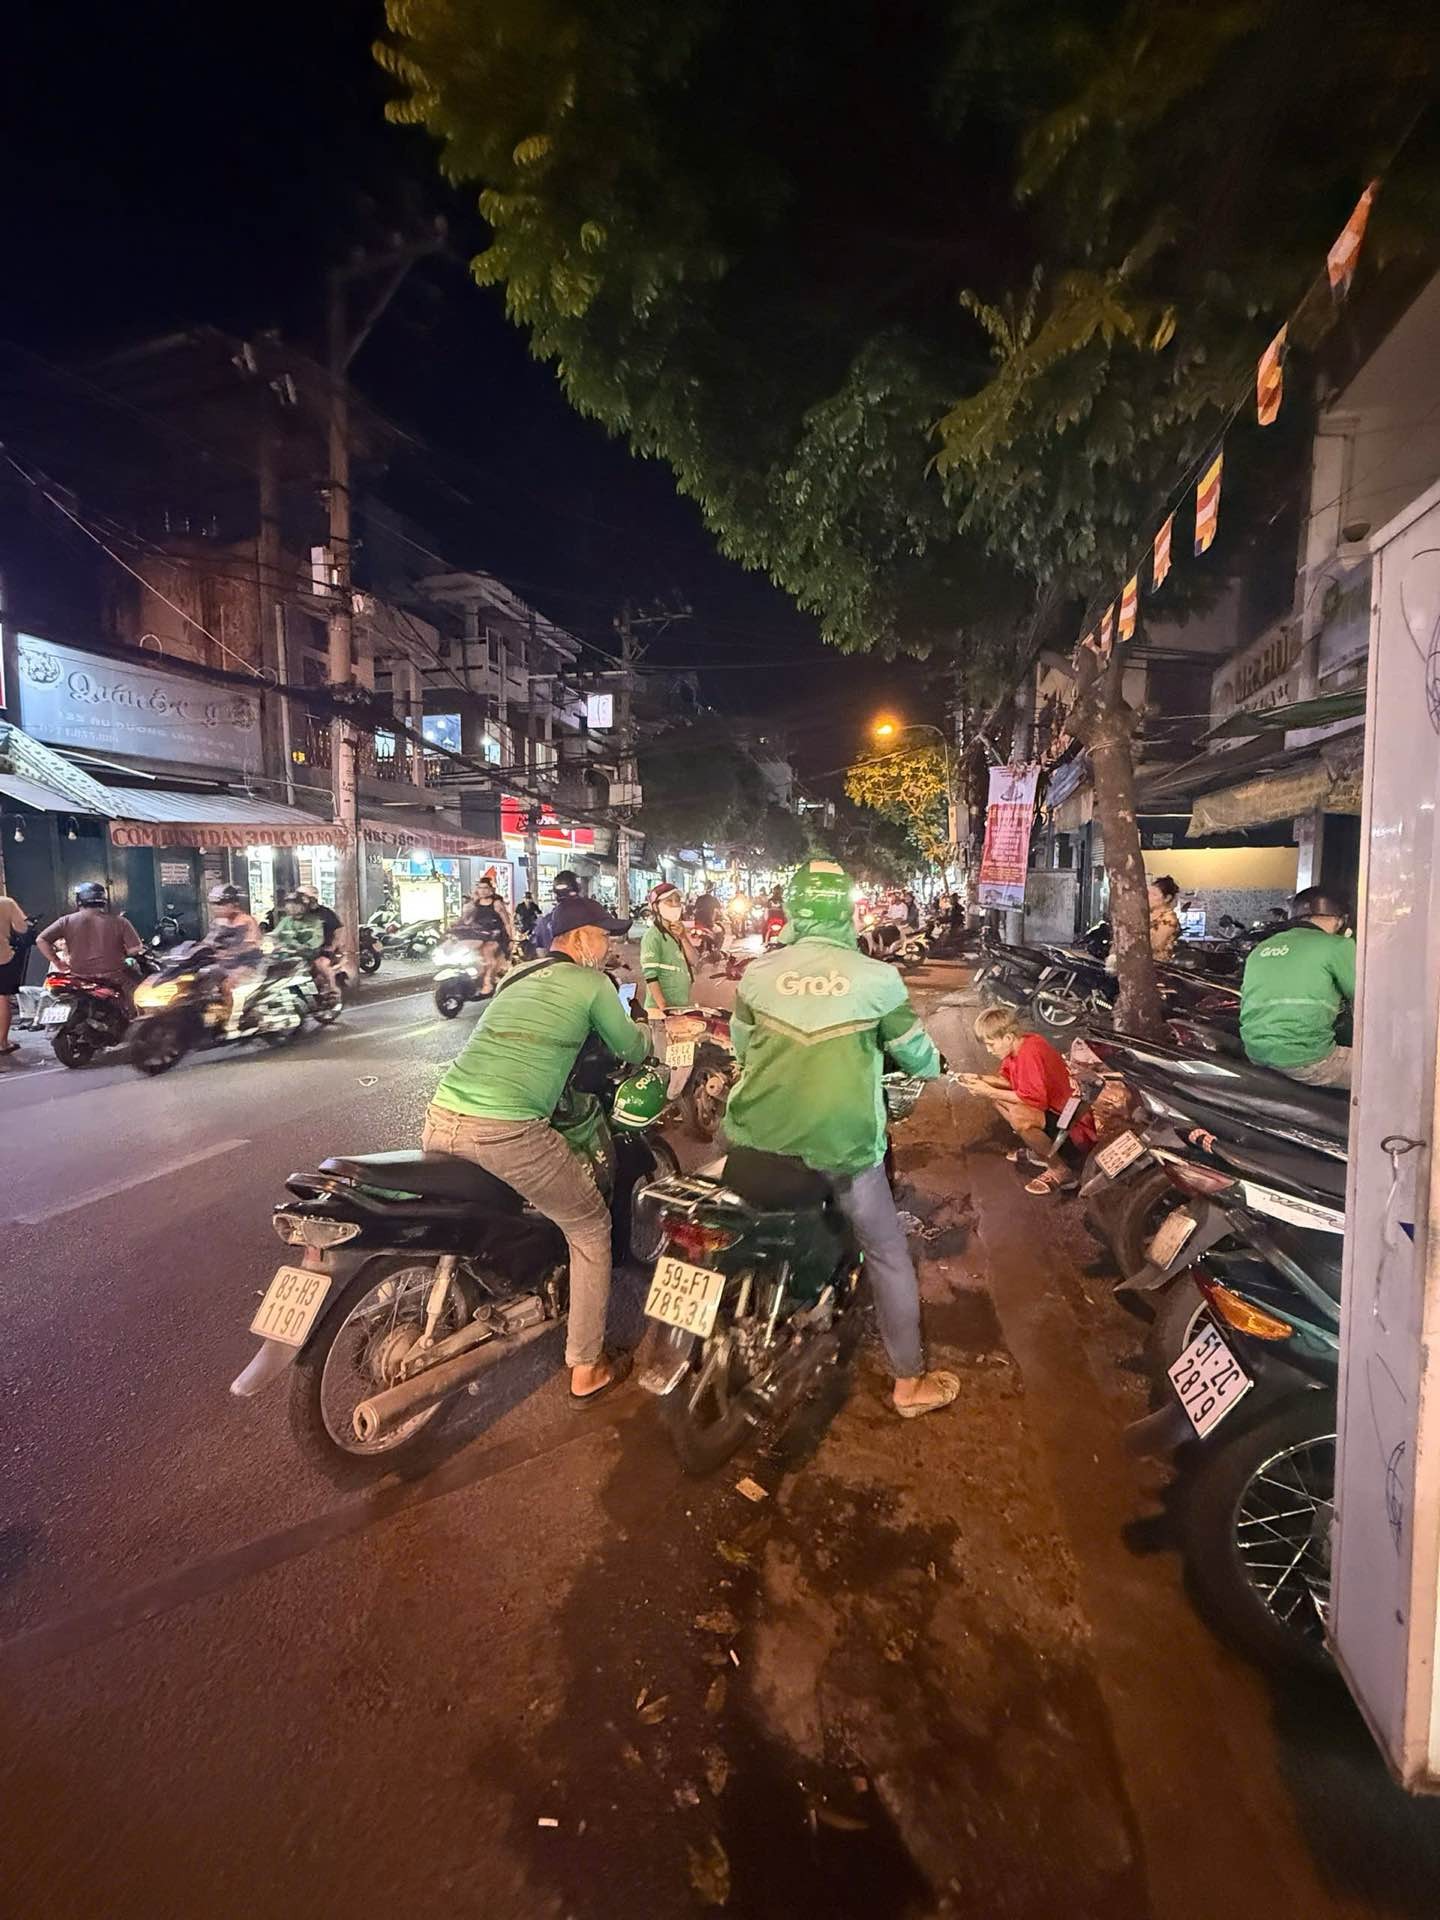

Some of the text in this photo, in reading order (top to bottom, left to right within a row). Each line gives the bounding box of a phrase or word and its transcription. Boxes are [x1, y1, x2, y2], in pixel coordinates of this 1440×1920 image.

[1260, 944, 1289, 957] Grab
[776, 969, 850, 997] Grab
[262, 1302, 306, 1338] 1190
[1173, 1358, 1216, 1424] 2879
